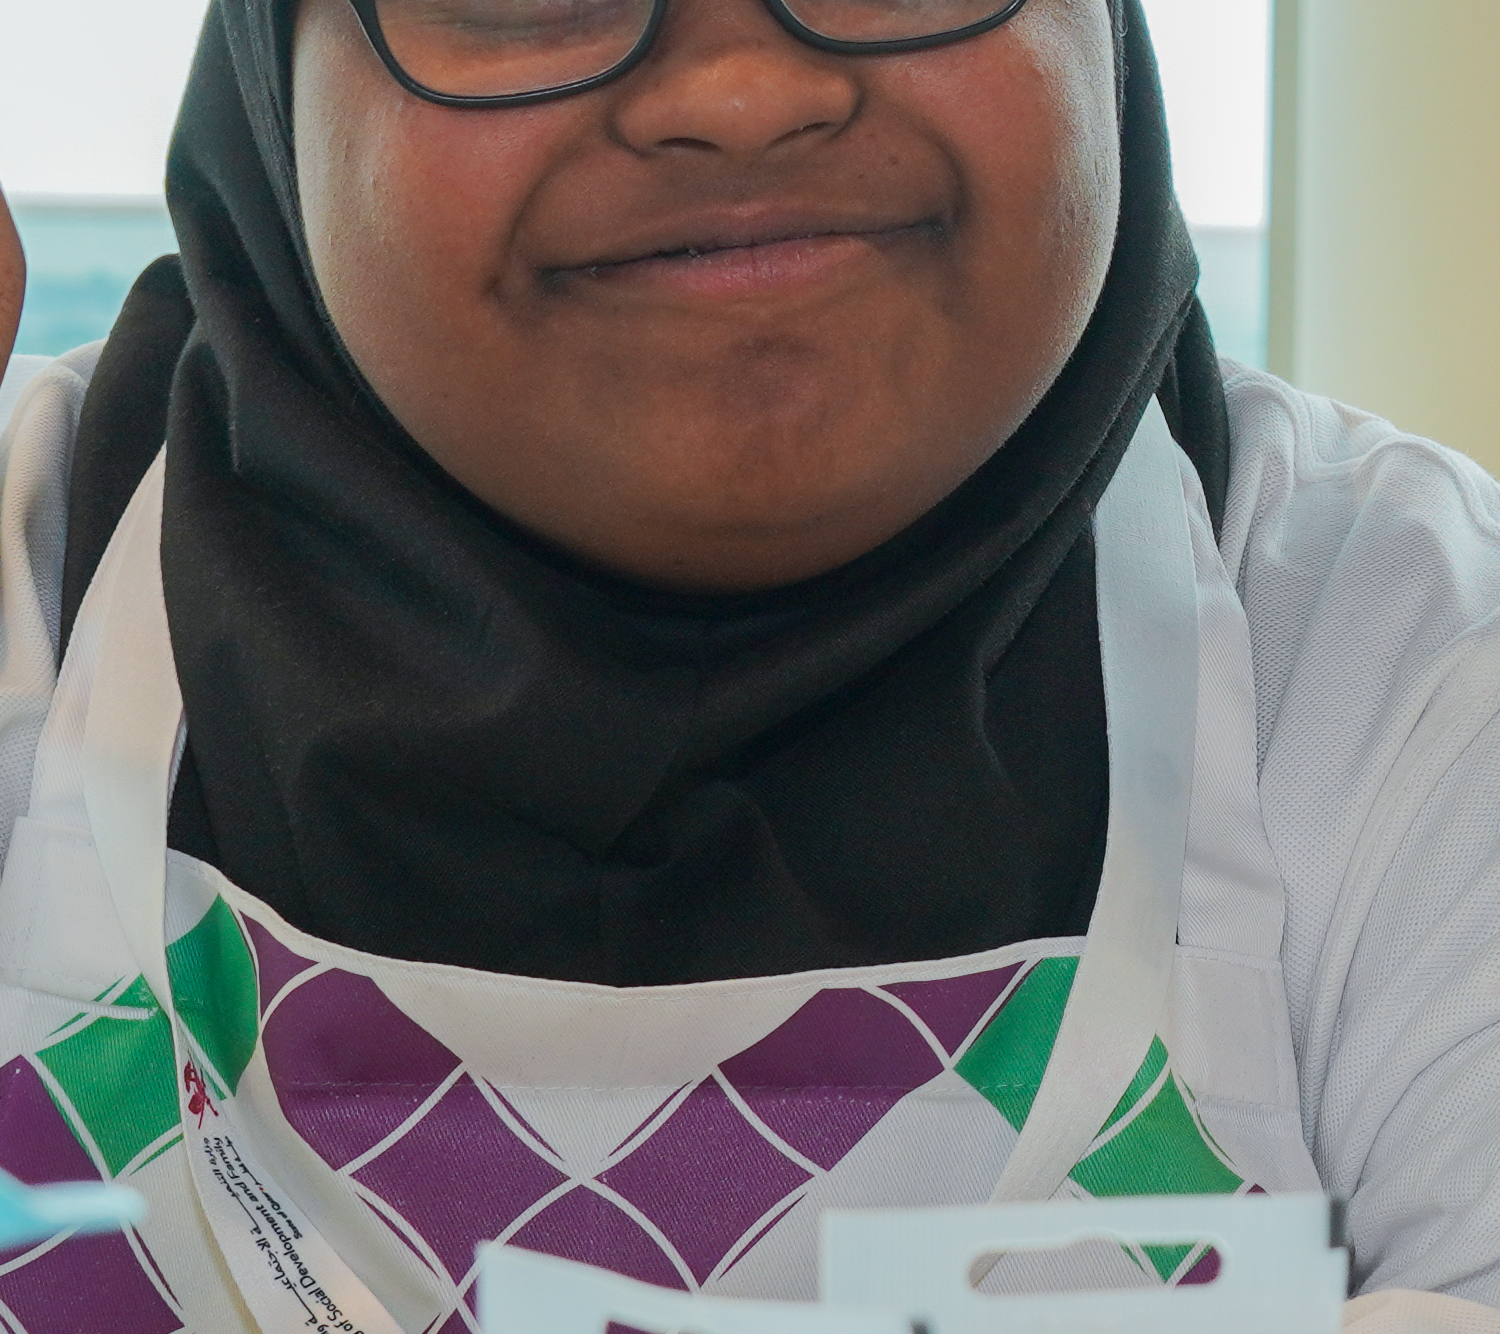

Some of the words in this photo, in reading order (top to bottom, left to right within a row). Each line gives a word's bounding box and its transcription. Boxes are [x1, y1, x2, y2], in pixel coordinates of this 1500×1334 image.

[213, 1137, 240, 1179] Family
[234, 1181, 259, 1202] and
[256, 1204, 317, 1288] Development
[308, 1287, 343, 1322] Social
[334, 1319, 354, 1332] of
